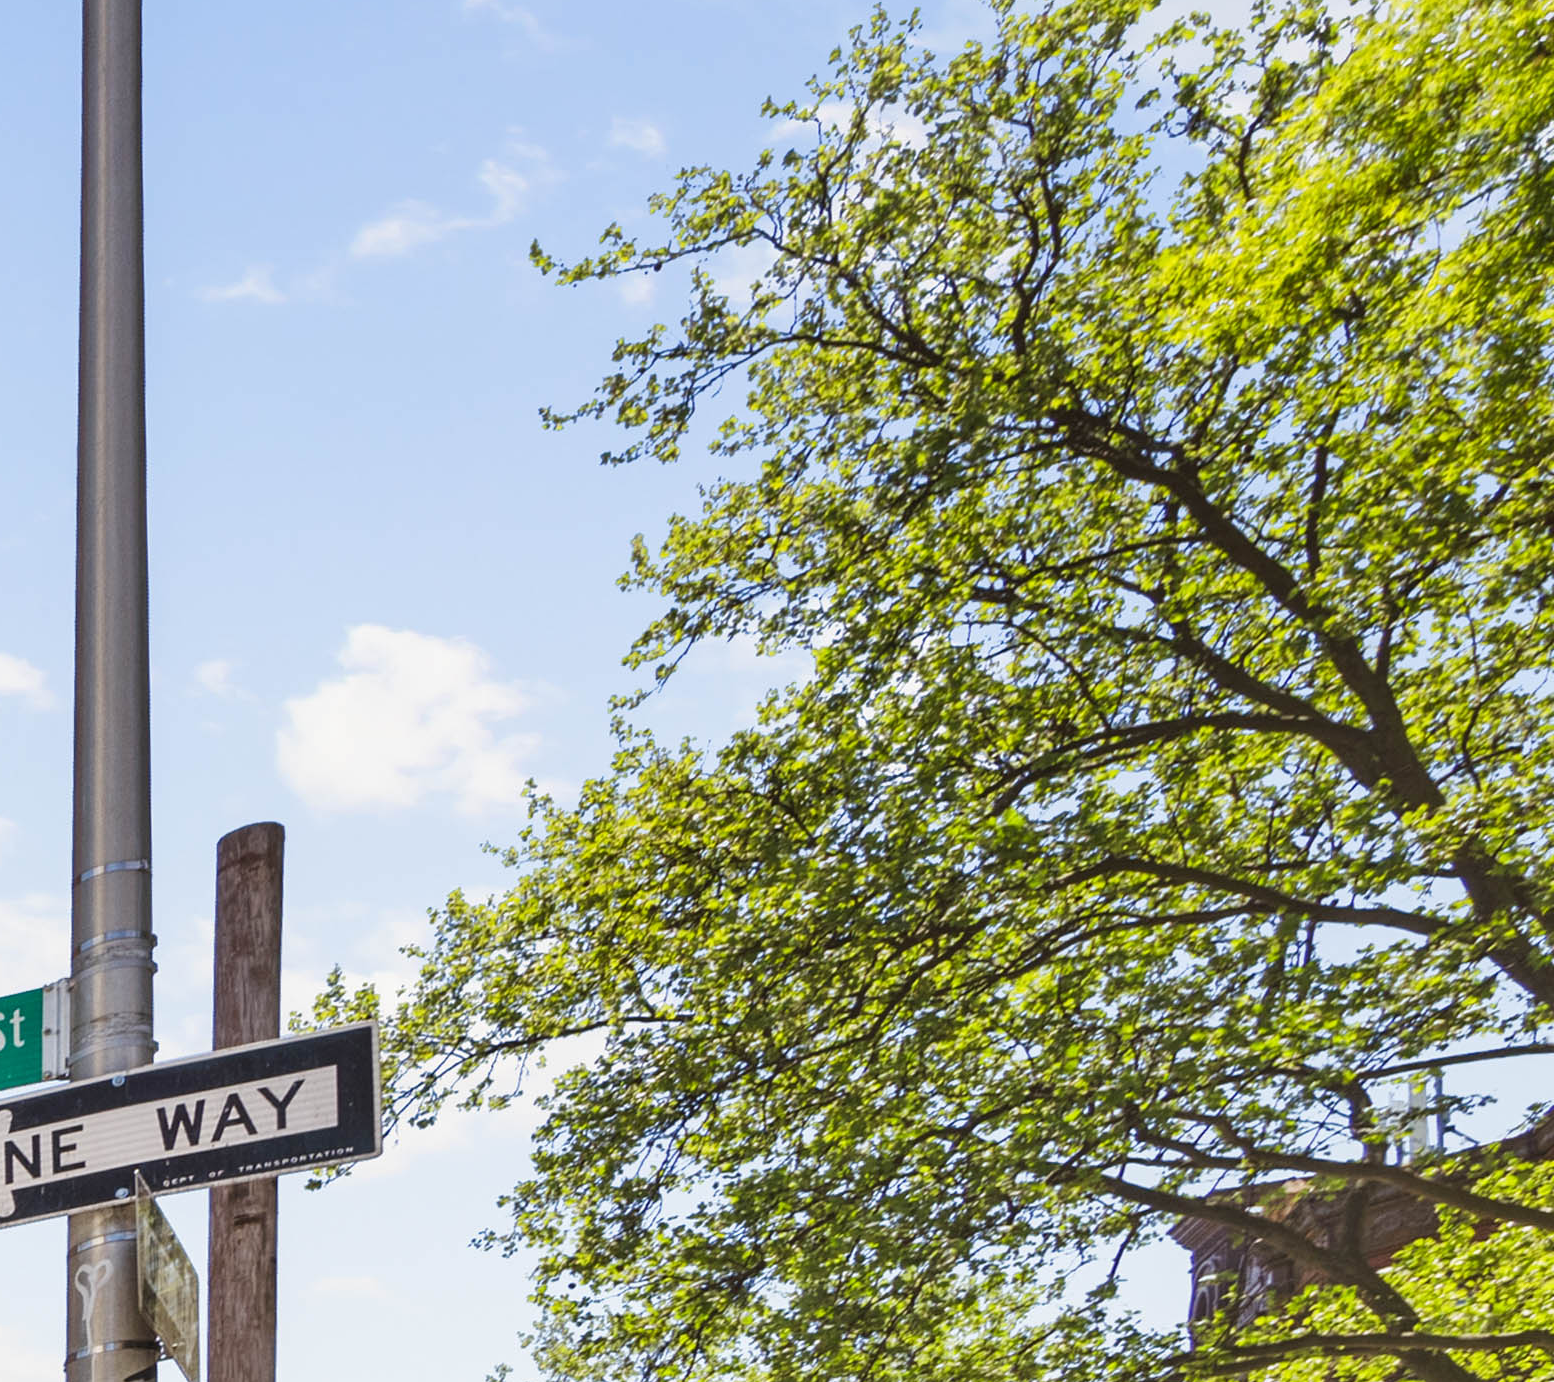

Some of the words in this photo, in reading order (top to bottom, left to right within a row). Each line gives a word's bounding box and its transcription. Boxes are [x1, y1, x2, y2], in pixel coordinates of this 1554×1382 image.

[156, 1079, 306, 1151] WAY
[162, 1175, 195, 1187] DEPT
[208, 1170, 225, 1179] OF
[238, 1146, 355, 1173] TRANSPORTATION
